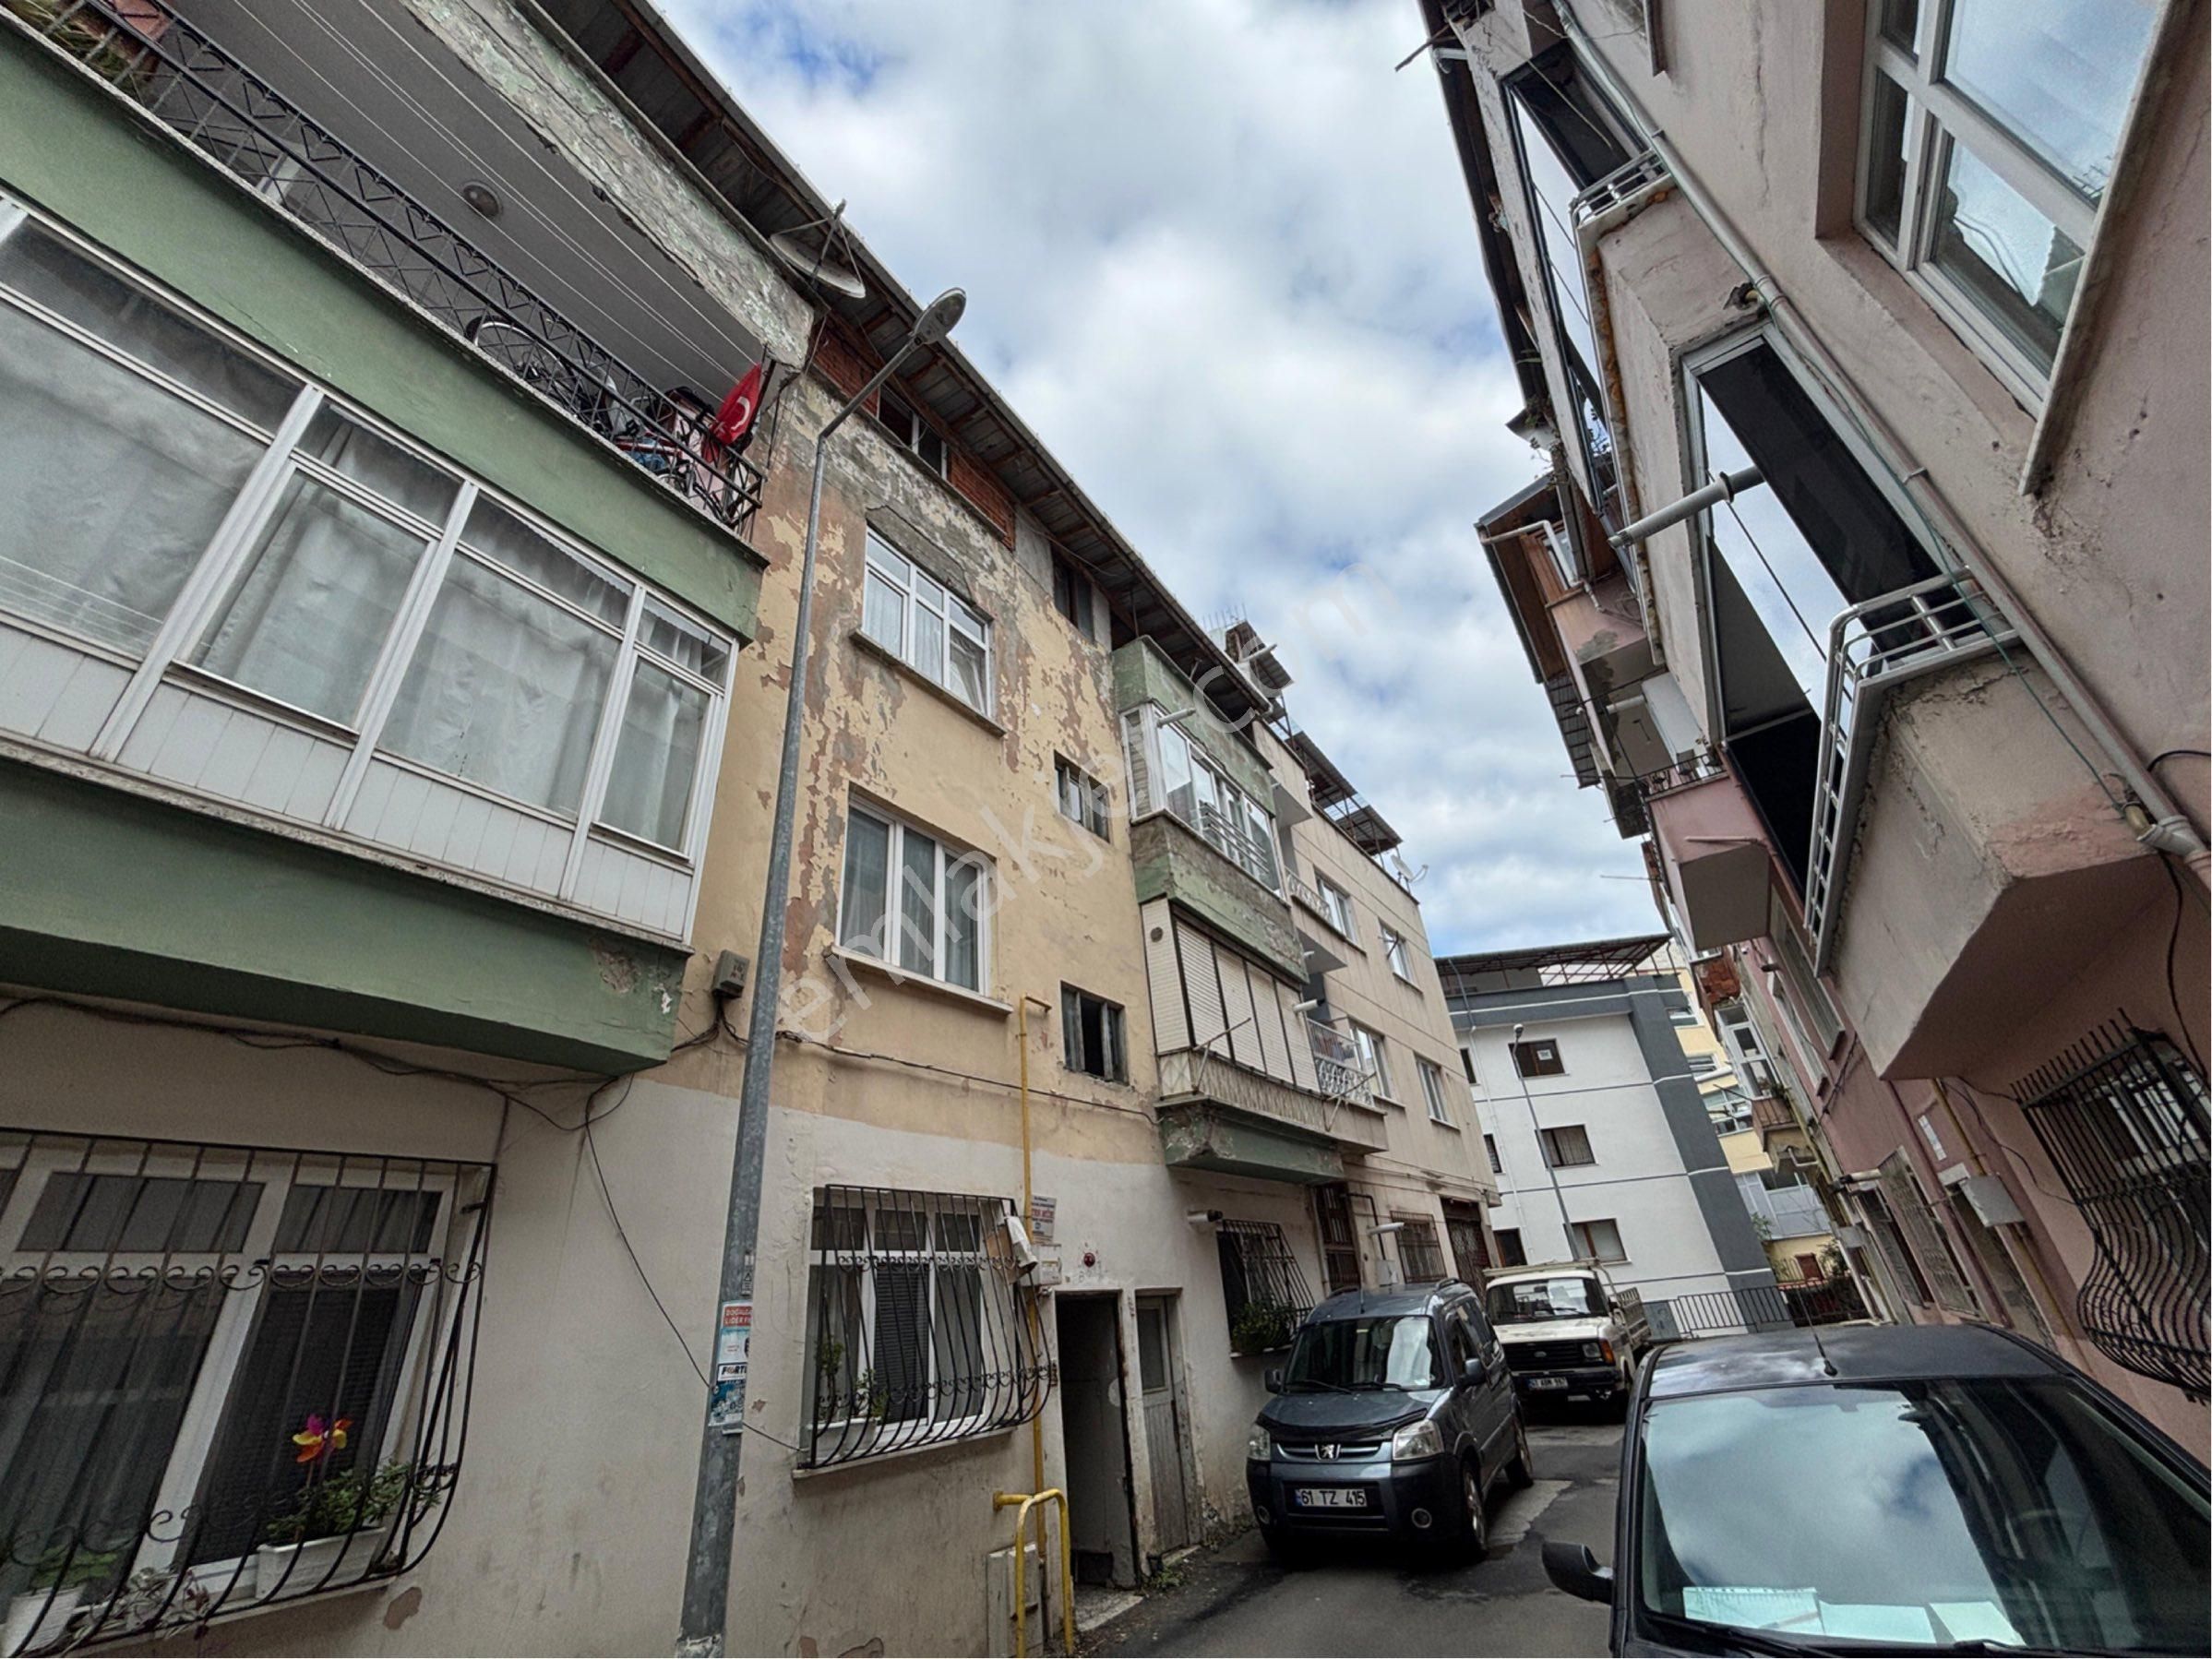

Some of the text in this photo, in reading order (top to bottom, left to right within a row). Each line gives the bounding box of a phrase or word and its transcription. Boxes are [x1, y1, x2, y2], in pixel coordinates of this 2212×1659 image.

[1300, 1490, 1366, 1506] 61 TZ 415
